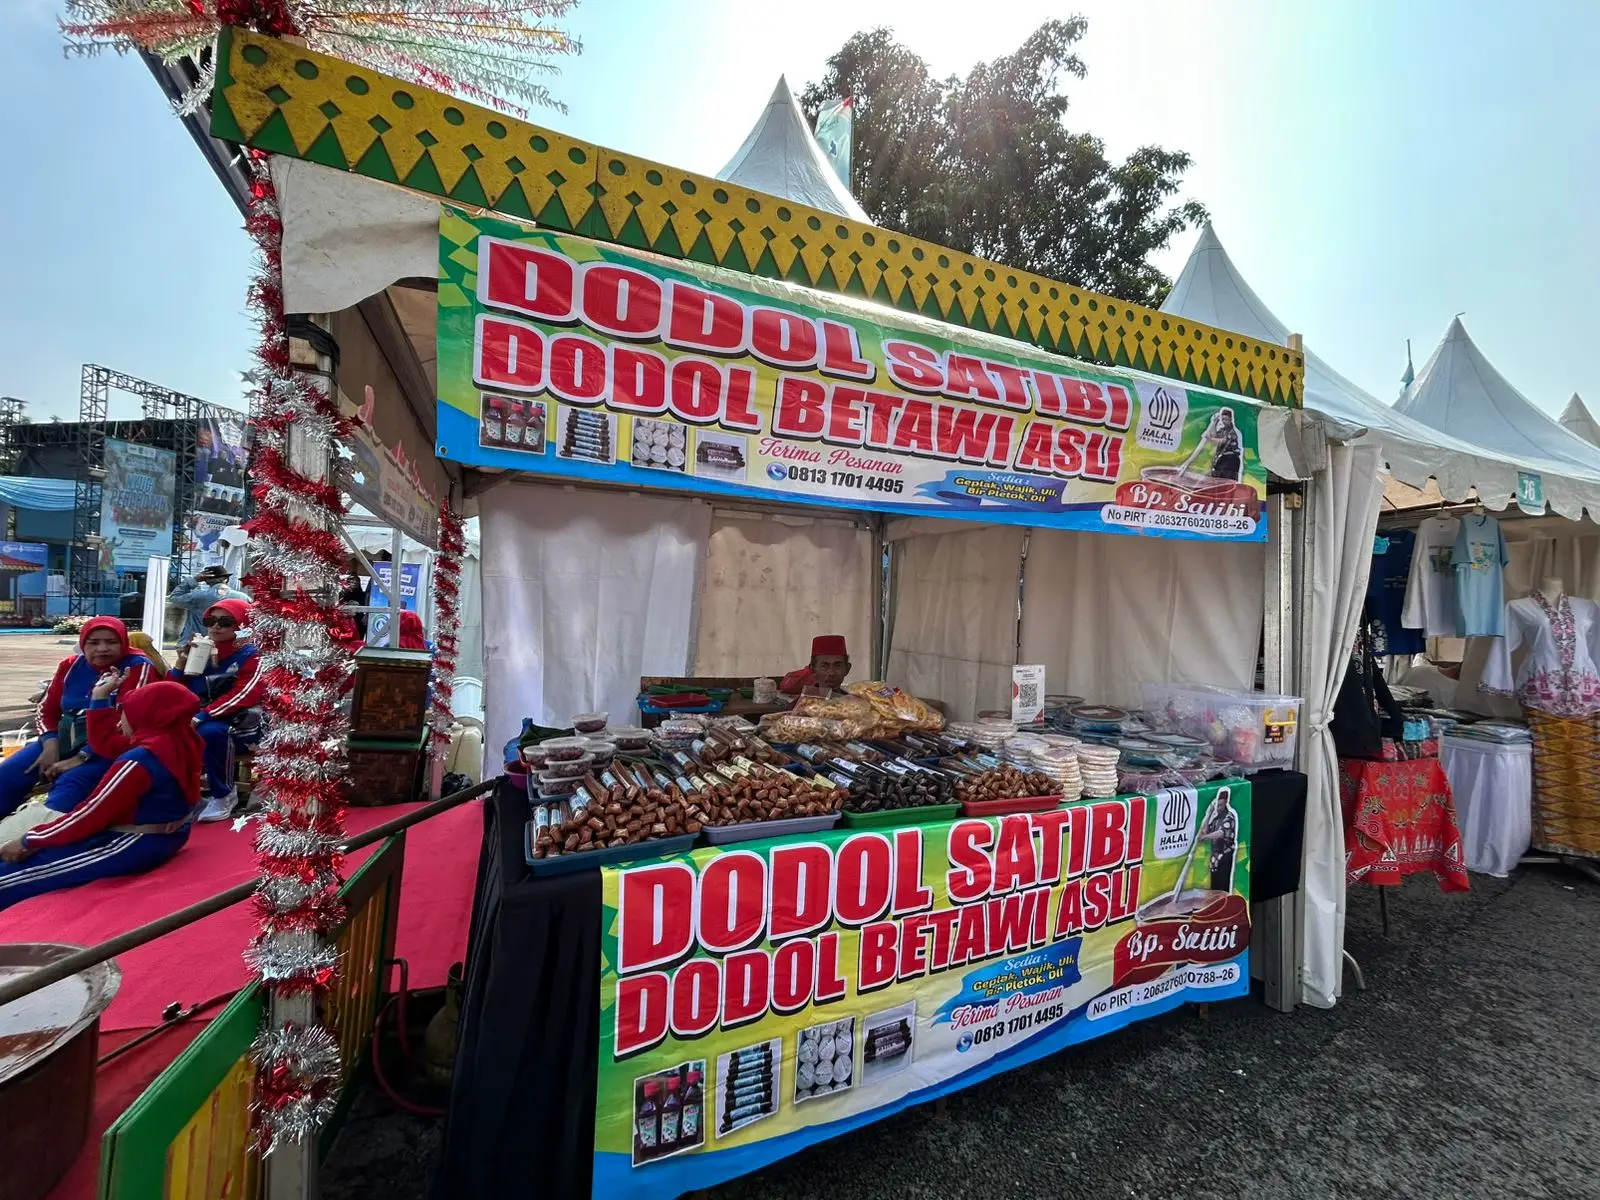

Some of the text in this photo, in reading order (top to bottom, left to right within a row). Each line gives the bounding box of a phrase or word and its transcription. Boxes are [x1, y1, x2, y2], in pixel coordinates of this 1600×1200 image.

[477, 235, 1133, 431] DODOL SATIBI
[474, 313, 1125, 484] DODOL BETAWI ASLI
[1142, 427, 1173, 441] HALAL
[758, 437, 821, 463] Terima
[827, 449, 903, 474] Pesanan
[788, 465, 904, 494] 0813 1701 4495
[955, 477, 1000, 490] Geplak,
[1003, 483, 1038, 496] Wajik,
[987, 472, 1023, 485] Sedia
[967, 487, 985, 496] Bir
[987, 490, 1028, 502] Pletok,
[1130, 483, 1246, 517] Bp. Satibi
[1107, 508, 1122, 520] No
[1124, 511, 1147, 524] PIRT
[1159, 833, 1189, 846] HALAL
[617, 796, 1148, 974] DODOL SATIBI
[1127, 924, 1239, 962] Bp. Satibi
[613, 866, 1143, 1063] DODOL BETAWI ASLI
[973, 955, 1075, 991] Geplak, Wajik, Uli,
[1003, 954, 1041, 971] Sedia
[1005, 976, 1046, 993] Pletok,
[1048, 968, 1064, 981] Dll
[950, 986, 1064, 1030] Terima Pesanan
[1093, 1002, 1107, 1016] No
[1109, 990, 1133, 1010] PIRT
[973, 1002, 1064, 1045] 0813 1701 4495
